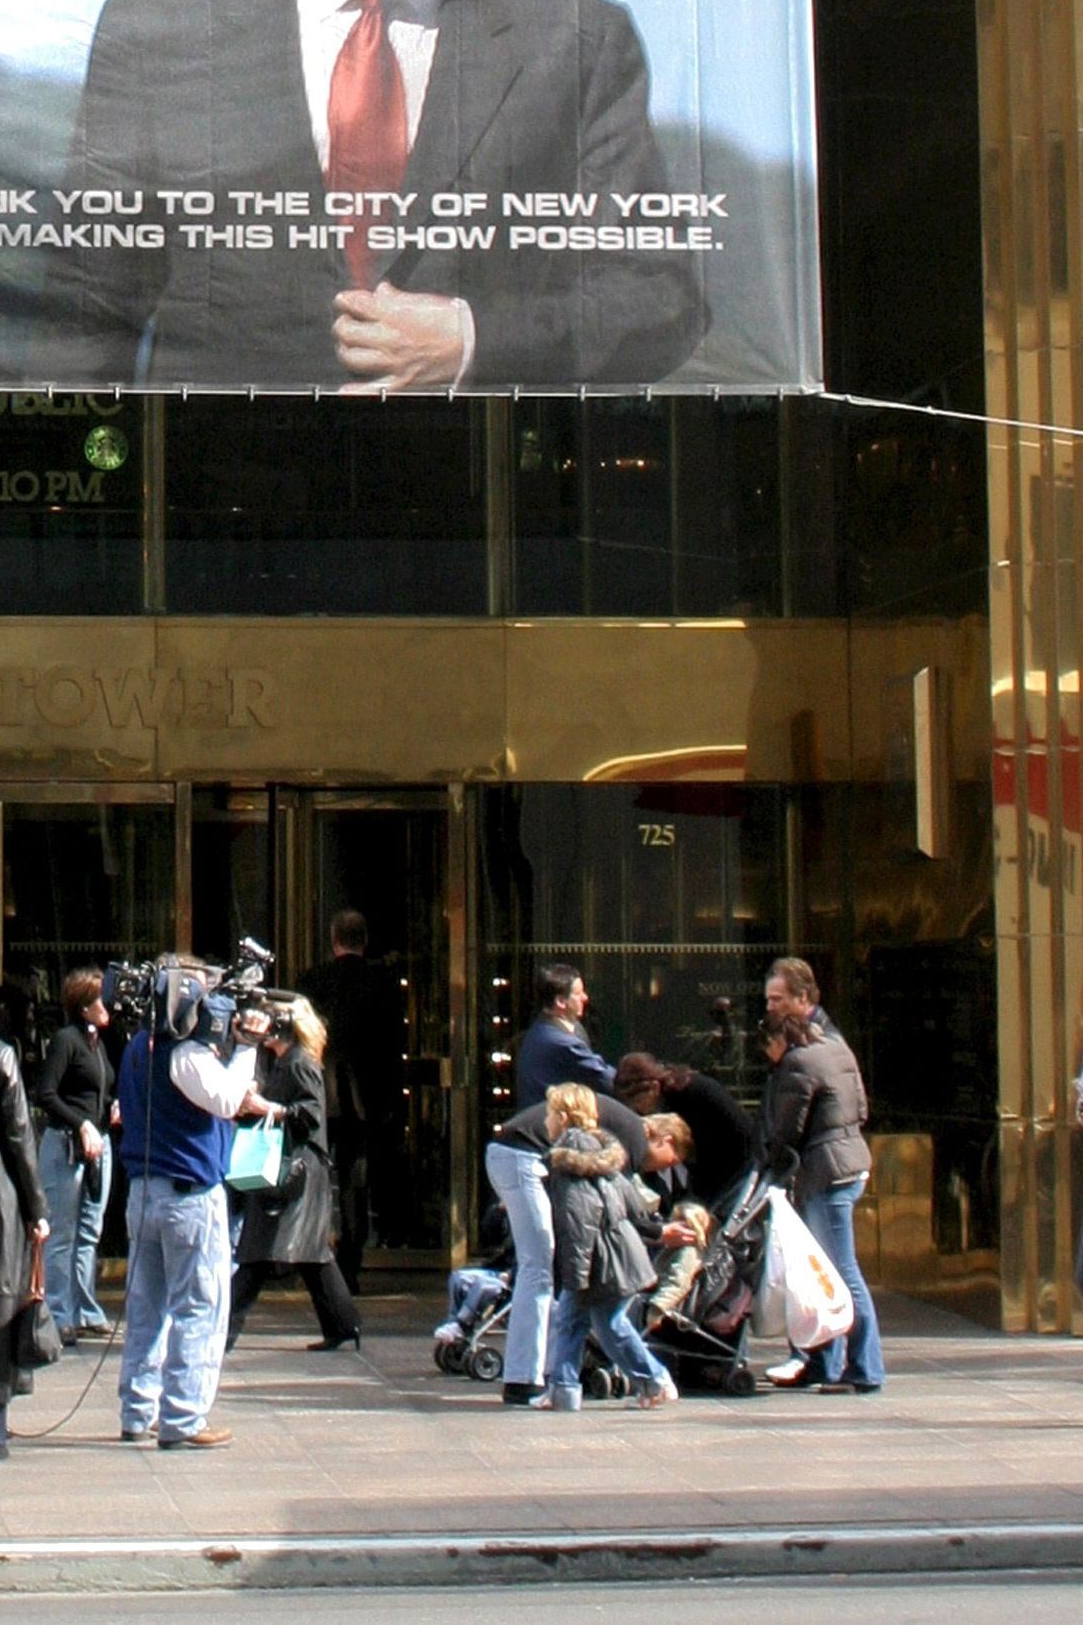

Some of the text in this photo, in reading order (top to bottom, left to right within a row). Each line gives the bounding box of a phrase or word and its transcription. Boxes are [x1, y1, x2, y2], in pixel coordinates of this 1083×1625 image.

[52, 189, 143, 215] YOU
[157, 190, 215, 215] TO
[228, 191, 310, 215] THE
[324, 192, 418, 217] CITY
[431, 192, 487, 217] OF
[502, 192, 598, 217] NEW
[610, 193, 729, 218] YORK
[178, 224, 273, 249] THIS
[288, 225, 354, 249] HIT
[367, 225, 496, 250] SHOW
[509, 226, 724, 251] POSSIBLE.
[638, 824, 675, 846] 725
